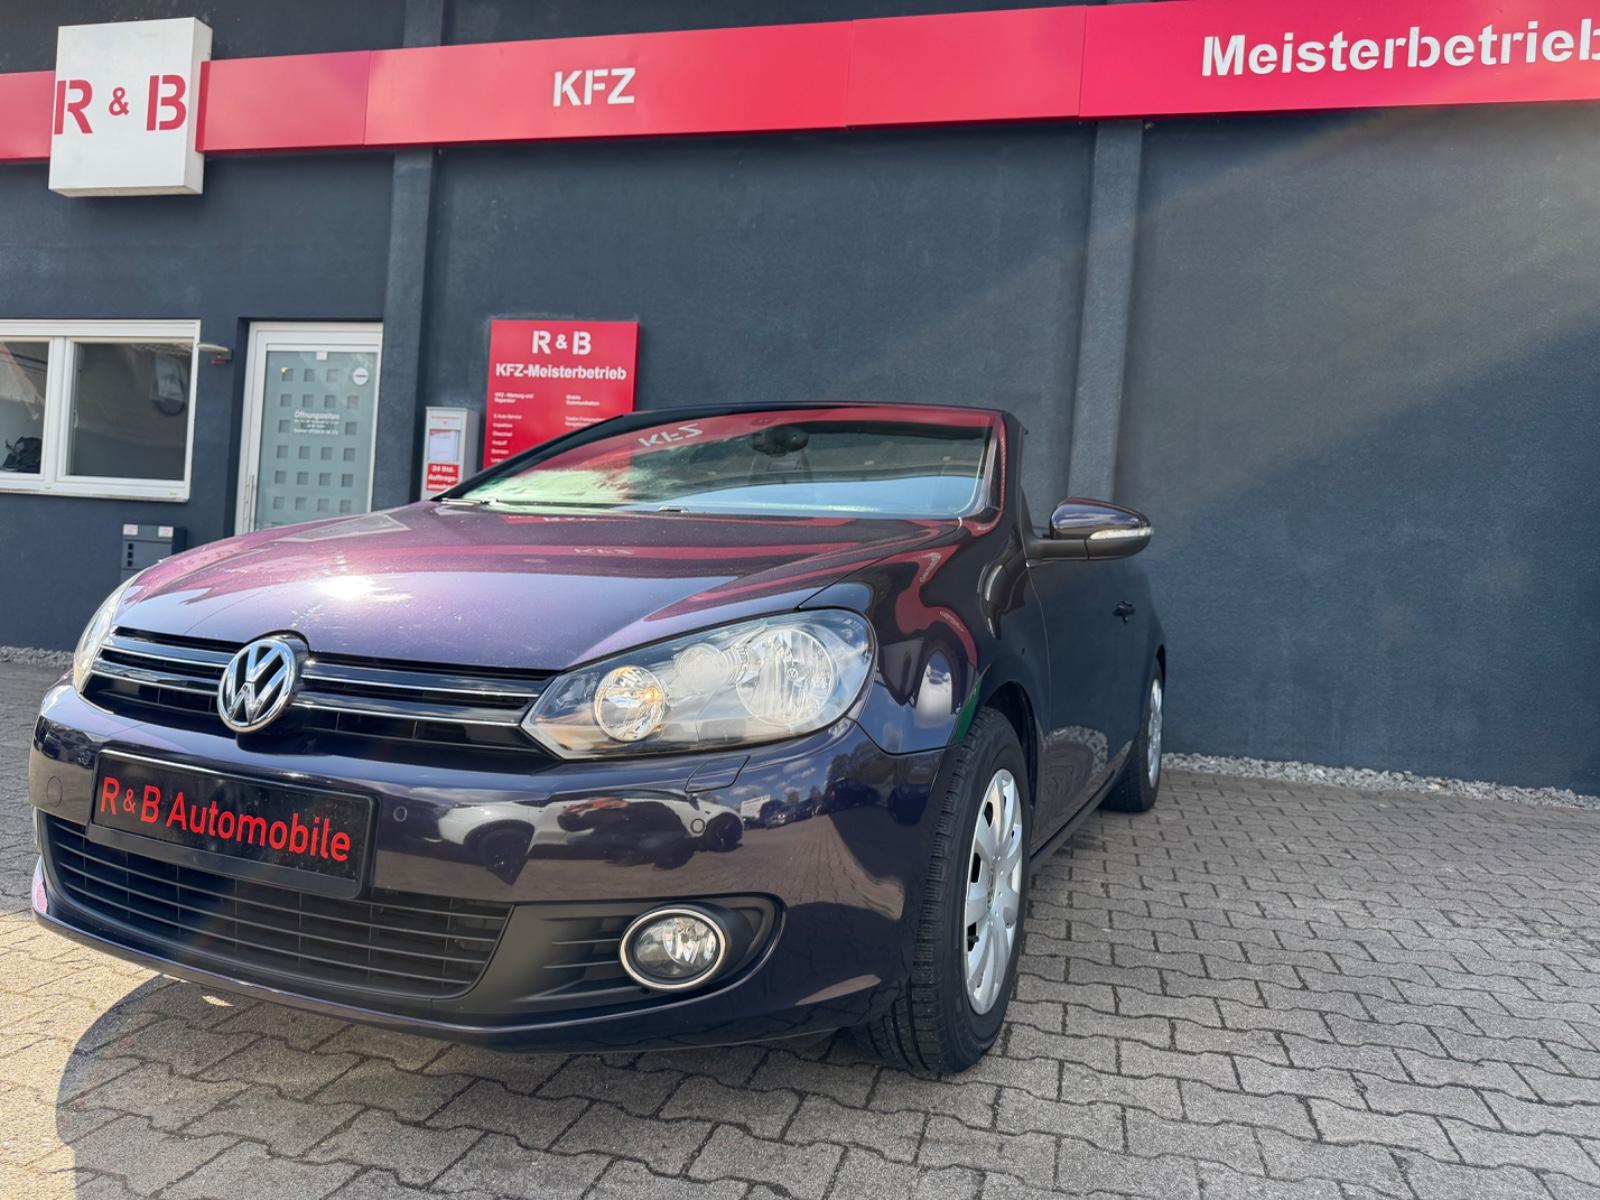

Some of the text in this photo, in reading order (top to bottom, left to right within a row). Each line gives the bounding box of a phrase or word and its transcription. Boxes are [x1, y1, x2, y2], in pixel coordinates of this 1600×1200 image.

[1201, 18, 1600, 77] Meisterbetrieb
[53, 74, 187, 135] R & B
[552, 67, 636, 107] KFZ
[532, 331, 591, 355] R & B
[495, 363, 627, 380] KFZ-Meisterbetrieb
[100, 777, 350, 861] R & B Automobile
